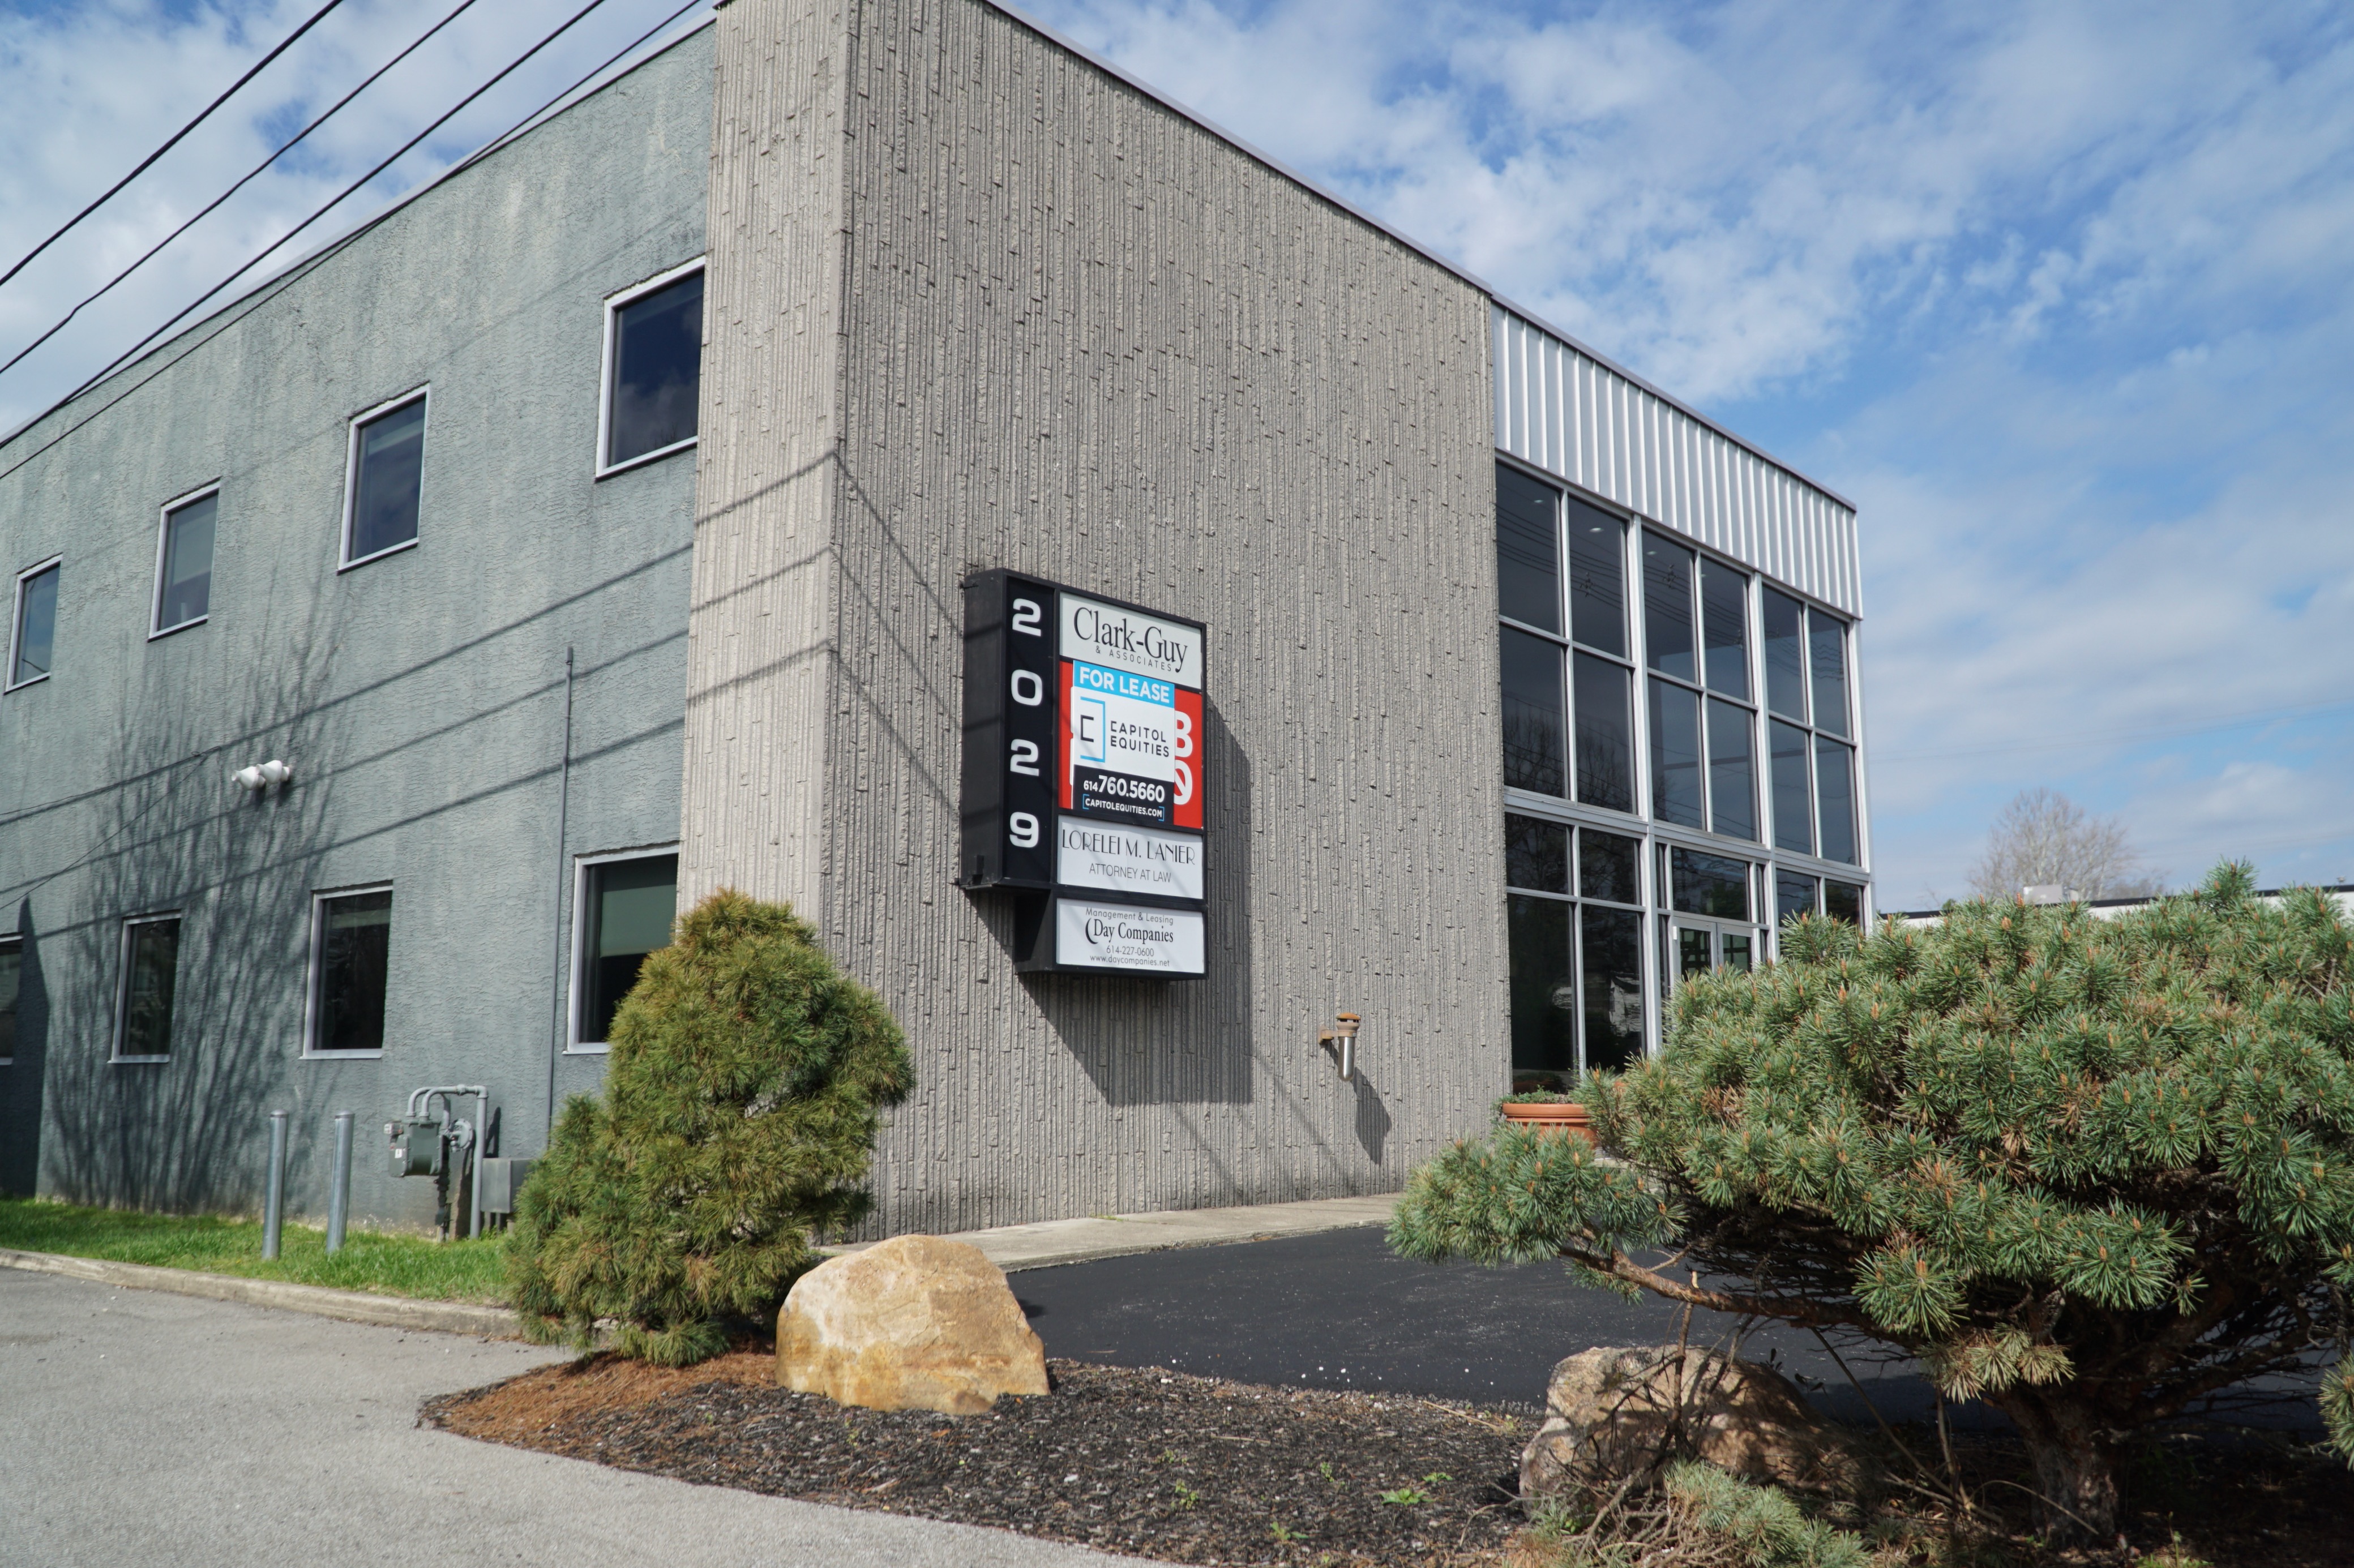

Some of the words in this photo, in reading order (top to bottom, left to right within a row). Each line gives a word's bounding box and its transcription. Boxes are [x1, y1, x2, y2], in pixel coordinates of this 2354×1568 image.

[1073, 607, 1188, 673] Clark-Guy
[1095, 645, 1101, 654] &
[1108, 649, 1172, 672] ASSOCIATES
[1080, 666, 1114, 691] FOR
[1119, 675, 1170, 703] LEASE
[1111, 721, 1166, 743] CAPITOL
[1110, 736, 1170, 757] EQUITIES
[1085, 798, 1162, 817] CAPITOLEQUITIES.COM
[1062, 829, 1120, 854] LORELEI
[1126, 838, 1141, 858] M.
[1147, 842, 1195, 865] LANIER
[1089, 863, 1138, 879] ATTORNEY
[1140, 868, 1151, 880] AT
[1153, 871, 1171, 883] LAW
[1085, 907, 1136, 921] Management
[1138, 912, 1144, 920] &
[1145, 913, 1174, 926] Leasing
[1094, 919, 1114, 942] Day
[1118, 923, 1174, 945] Companies
[1090, 954, 1170, 967] www.daycompanies.net
[1106, 945, 1154, 957] 614-227-0600
